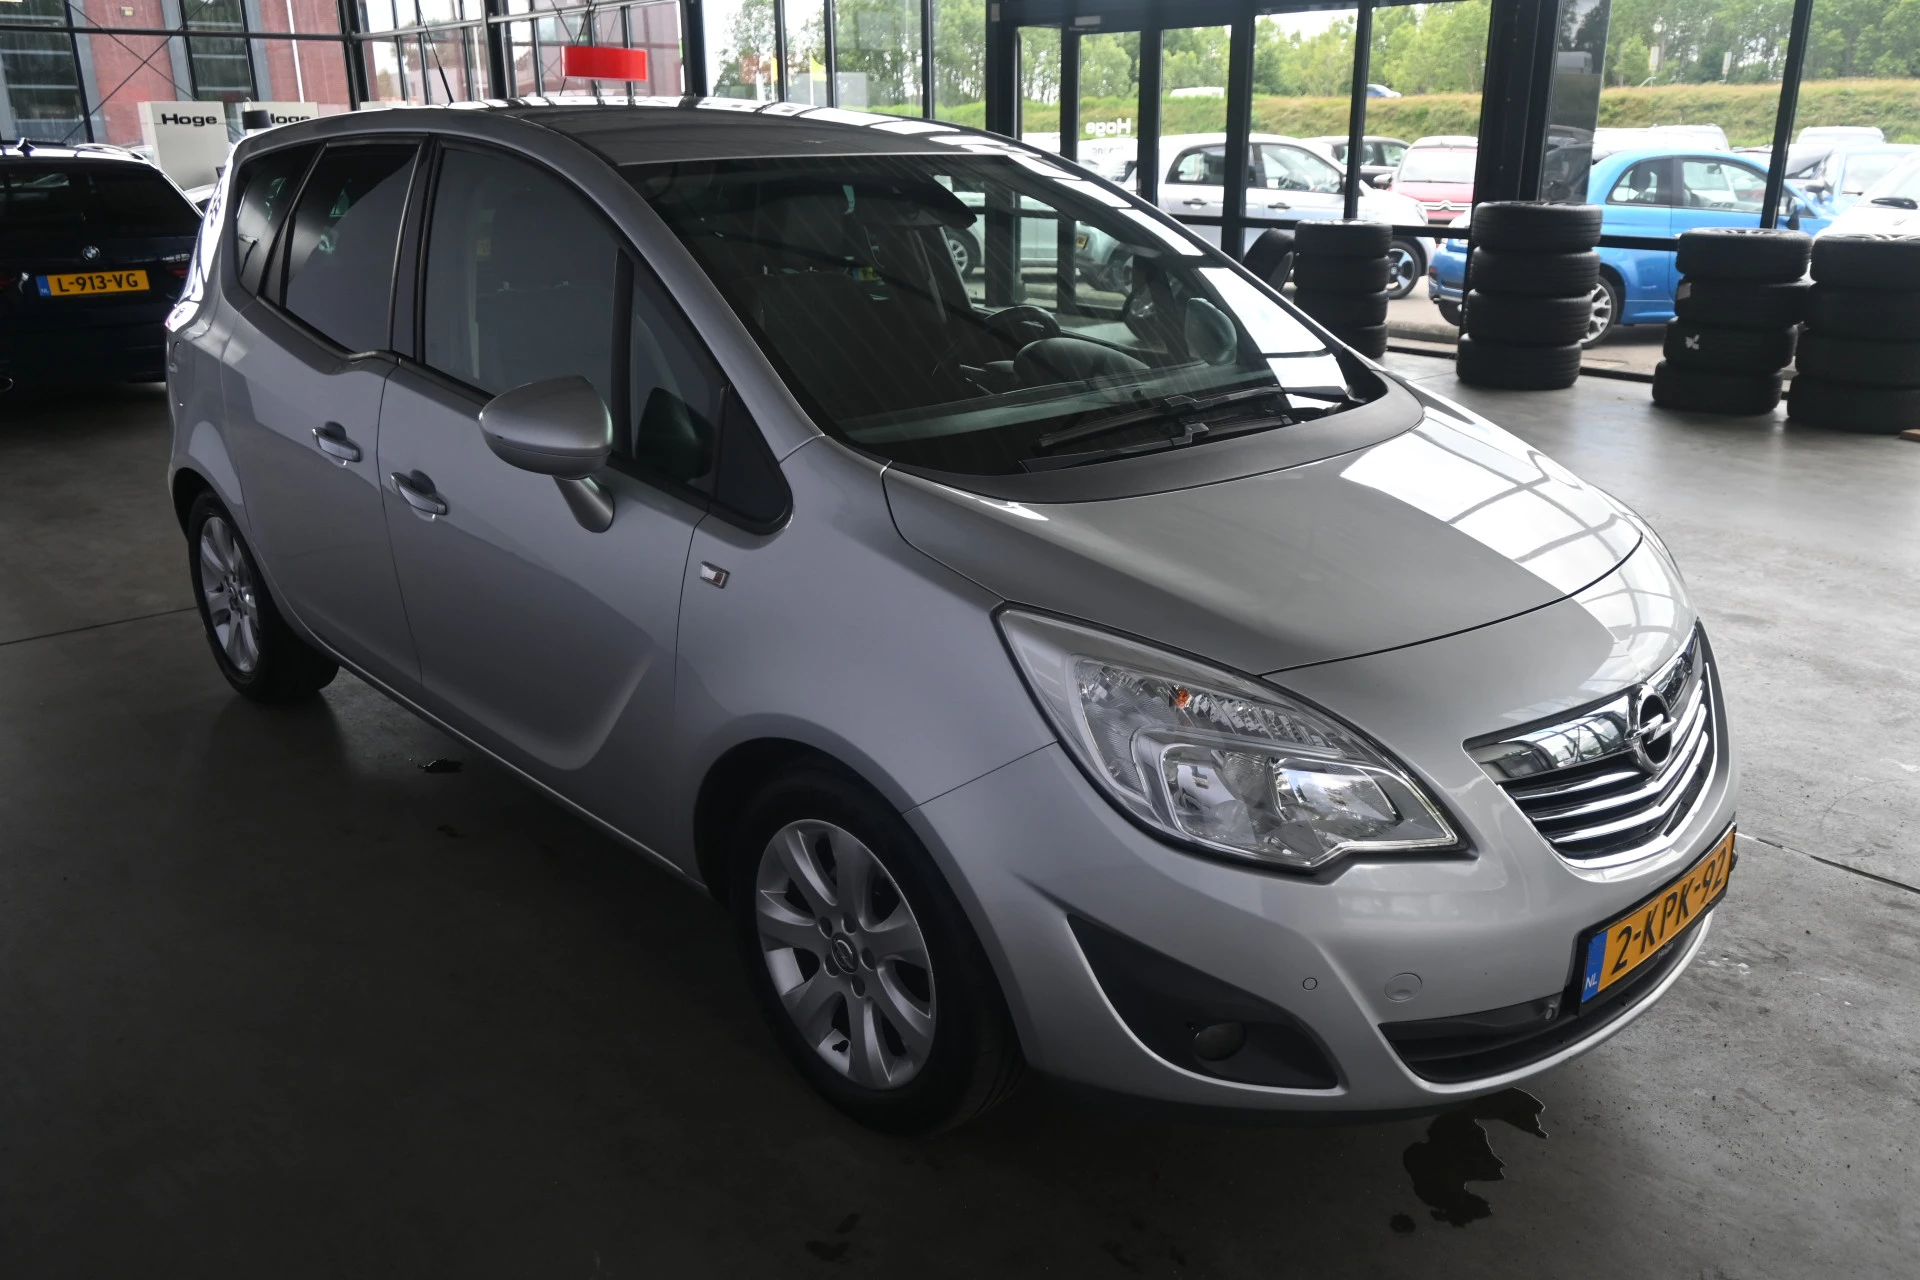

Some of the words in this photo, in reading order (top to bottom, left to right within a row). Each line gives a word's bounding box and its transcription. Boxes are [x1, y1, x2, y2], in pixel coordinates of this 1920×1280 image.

[161, 113, 218, 127] Hoge
[57, 272, 139, 293] L-913-VG
[1611, 846, 1728, 976] 2-KPK-92
[1584, 976, 1598, 991] NL
